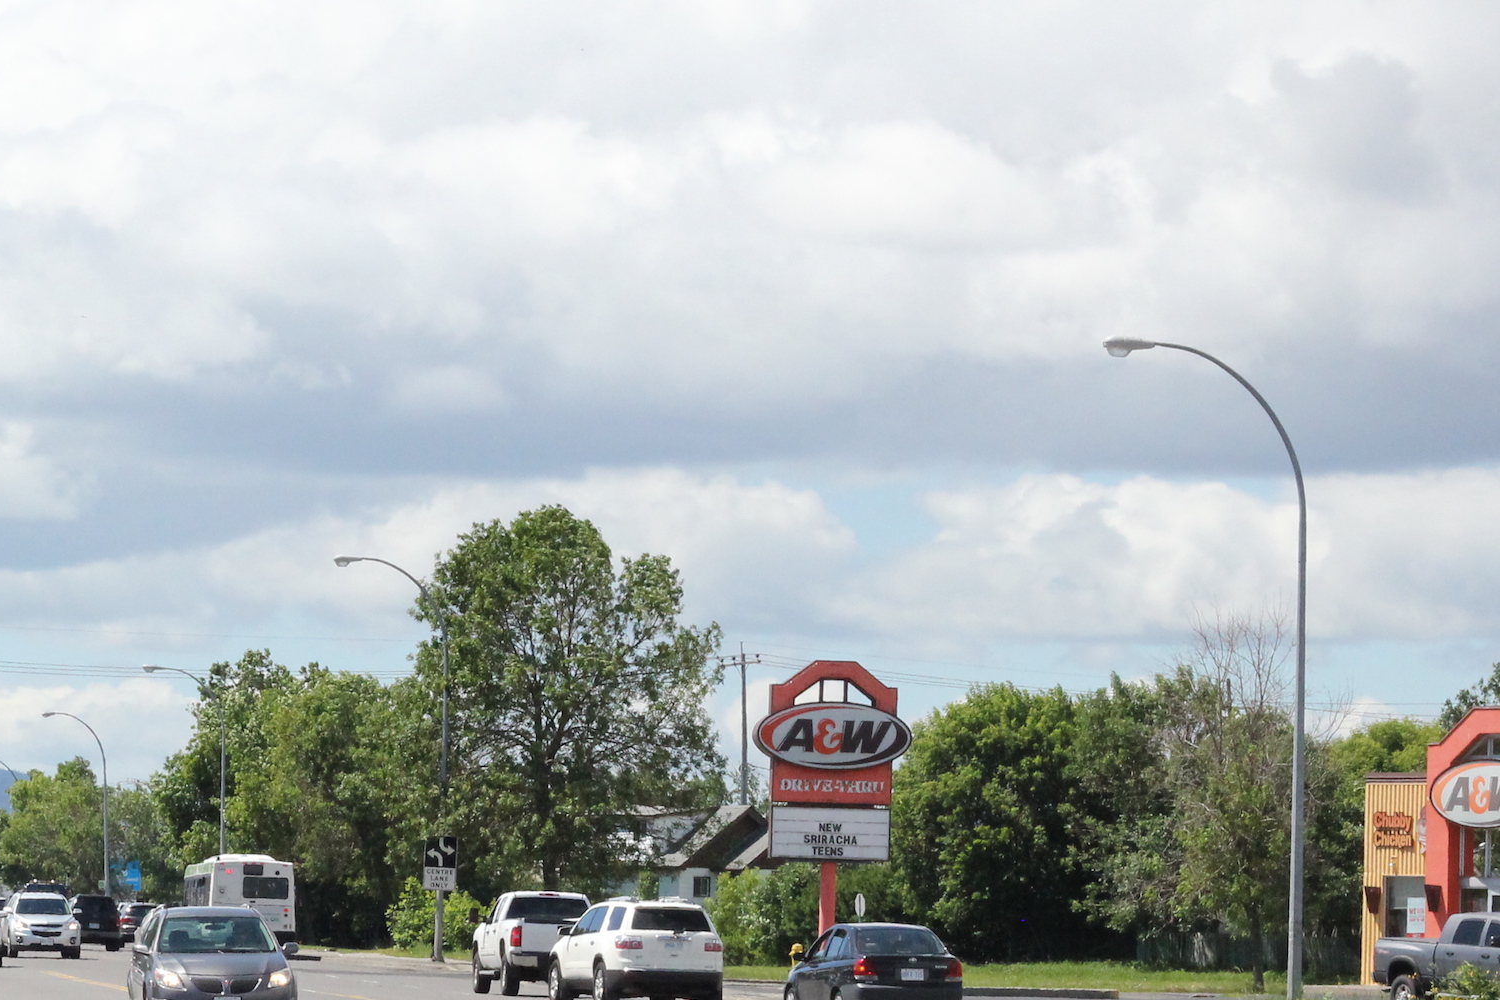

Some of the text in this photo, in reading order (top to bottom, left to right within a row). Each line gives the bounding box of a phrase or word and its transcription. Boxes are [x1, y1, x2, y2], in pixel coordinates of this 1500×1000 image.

[777, 718, 892, 755] A&W
[779, 778, 885, 794] DRIVE-THRU
[819, 823, 842, 832] NEW
[1374, 811, 1412, 831] Chubby
[804, 835, 857, 845] SRIRACHA
[1374, 830, 1412, 848] Chicken
[812, 846, 844, 856] TEENS
